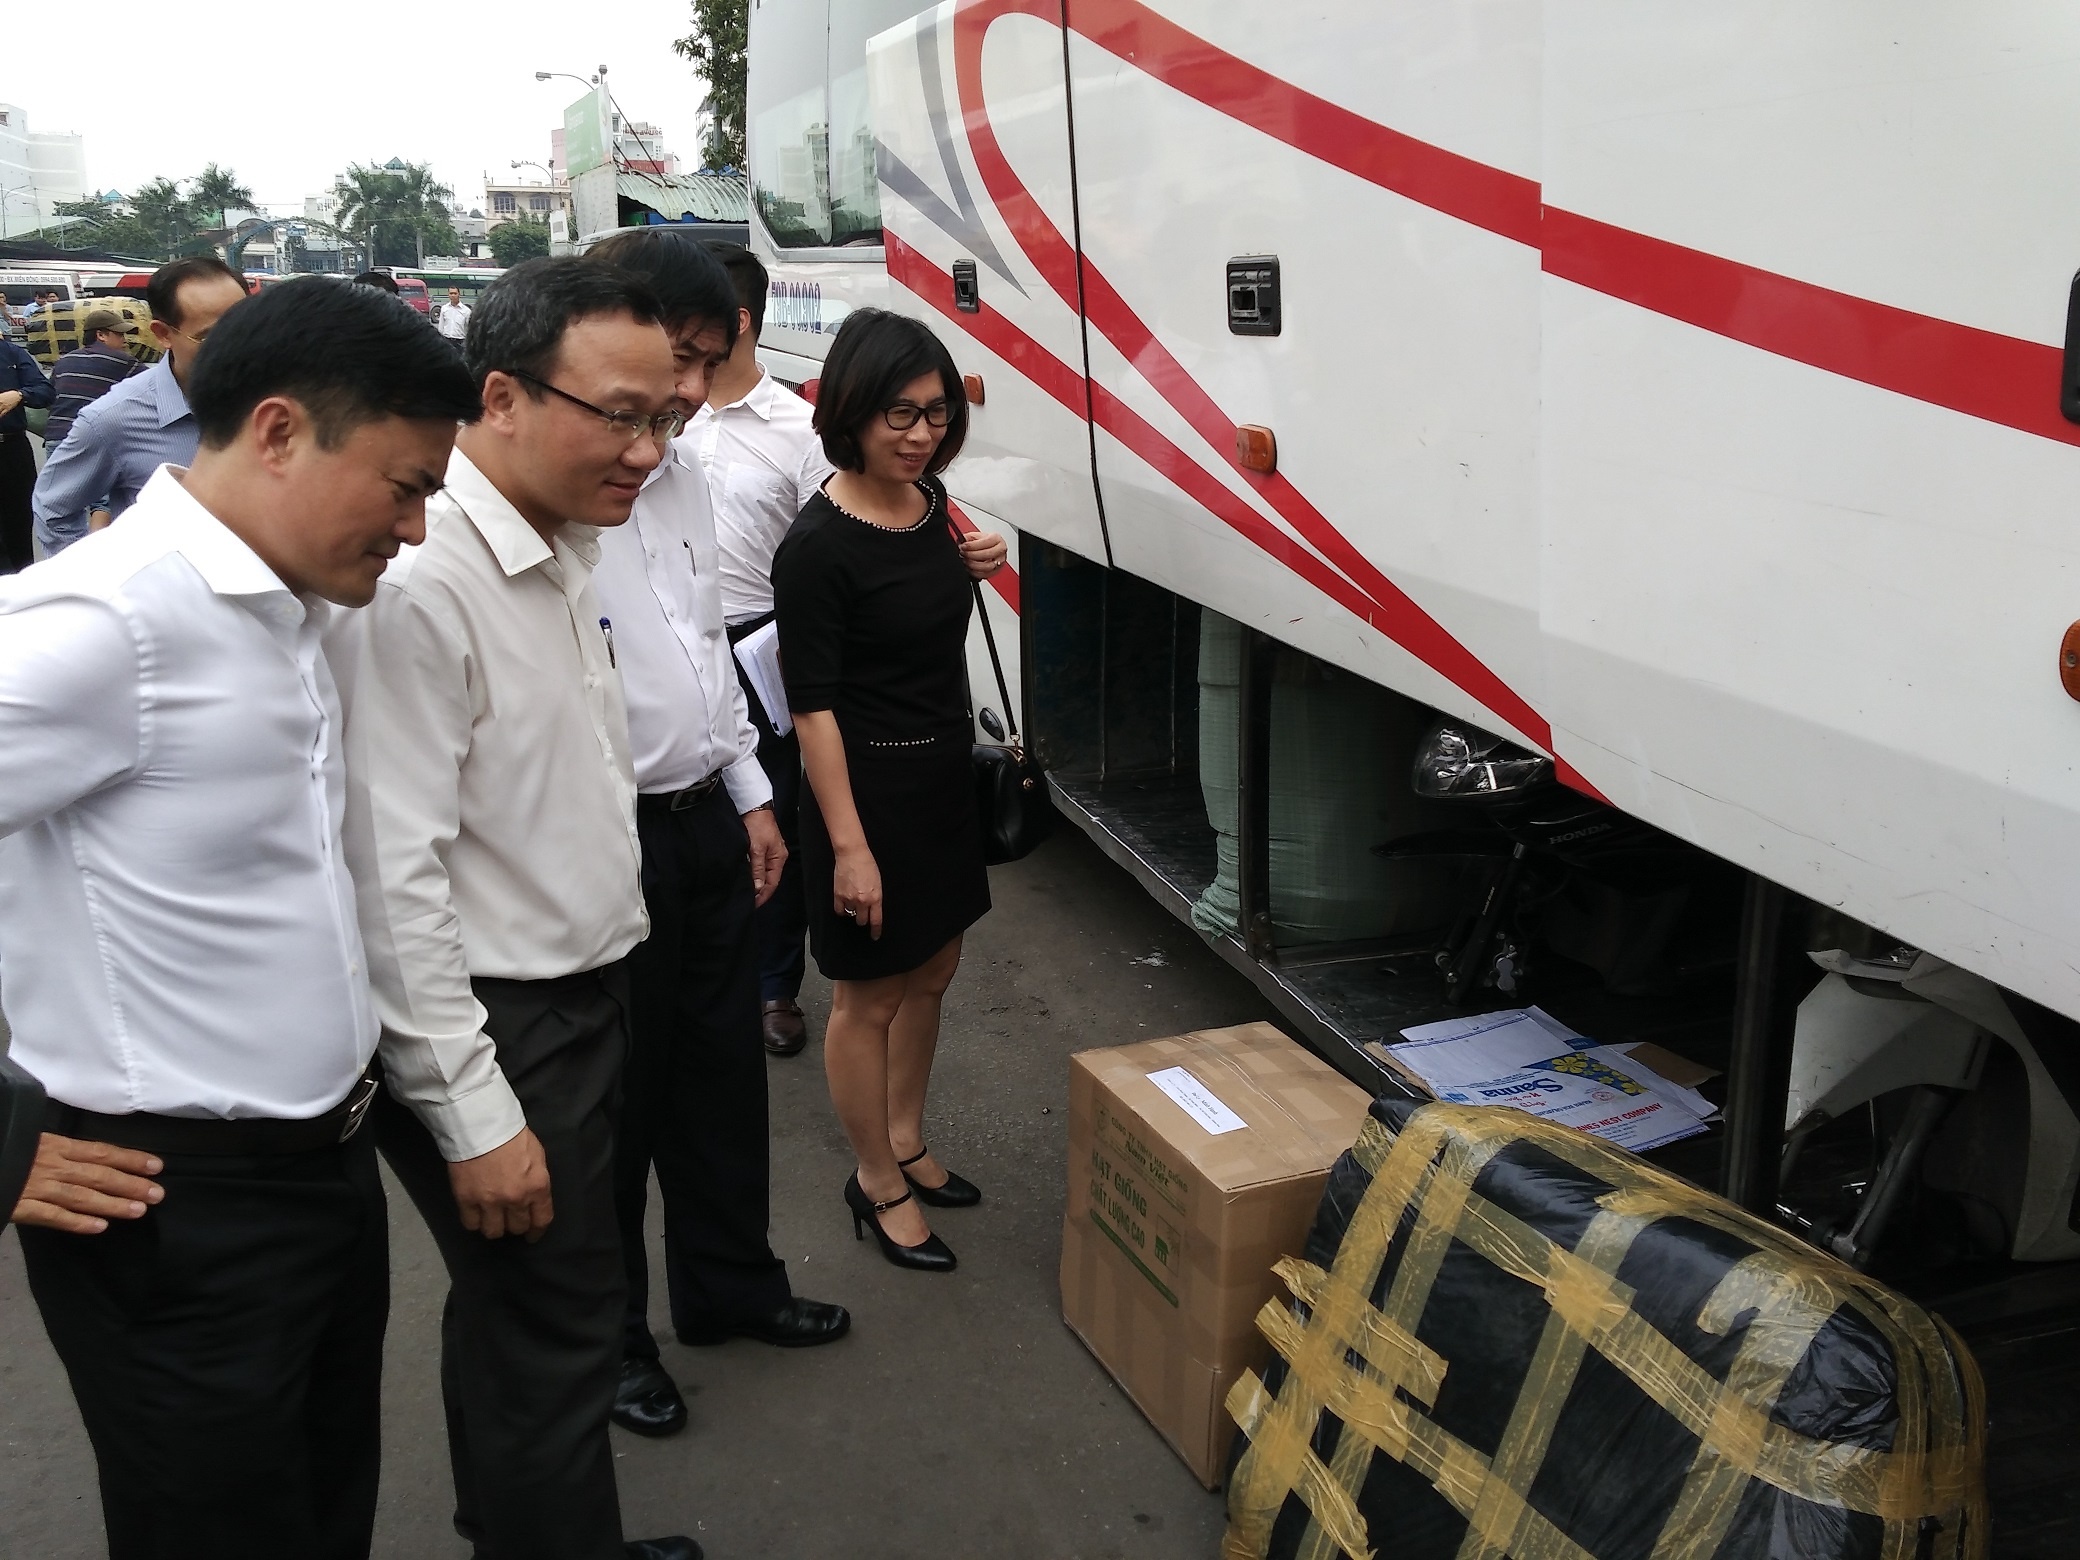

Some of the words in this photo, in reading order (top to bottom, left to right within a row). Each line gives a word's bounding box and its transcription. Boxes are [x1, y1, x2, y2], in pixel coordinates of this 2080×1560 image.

[1549, 823, 1613, 845] HONDA
[1478, 1077, 1564, 1098] Sanna
[1573, 1122, 1600, 1132] ANES
[1600, 1115, 1623, 1129] NEST
[1621, 1102, 1664, 1120] COMPANY
[1128, 1131, 1136, 1143] TY
[1125, 1140, 1147, 1166] Nam
[1091, 1151, 1112, 1180] HẠT
[1114, 1171, 1147, 1218] GIỐNG
[1108, 1199, 1130, 1235] LƯỢNG
[1130, 1221, 1145, 1249] CAO
